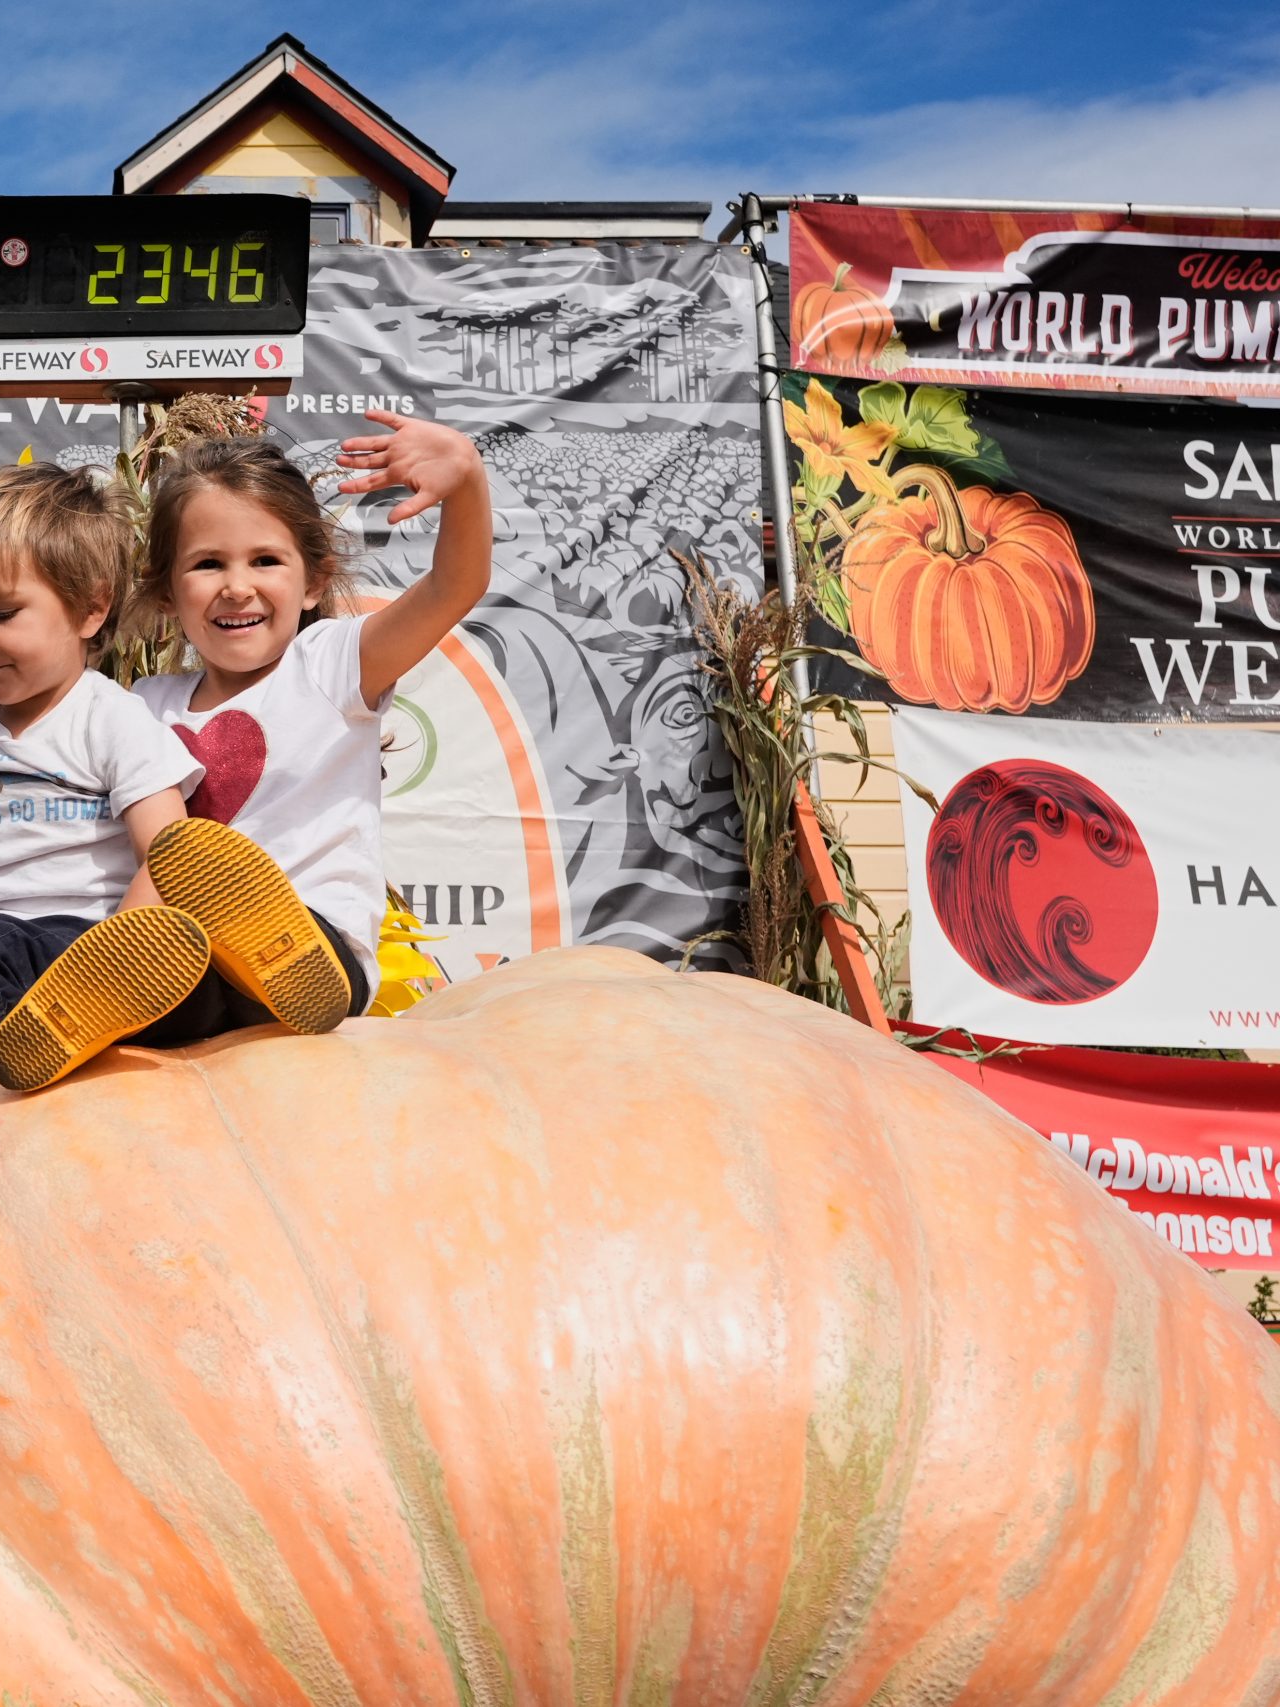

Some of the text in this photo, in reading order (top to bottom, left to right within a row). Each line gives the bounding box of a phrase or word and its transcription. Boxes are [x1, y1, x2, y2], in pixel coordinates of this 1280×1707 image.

[87, 242, 265, 305] 2346
[958, 291, 1280, 362] WORLD PUM
[145, 348, 251, 369] SAFEWAY
[286, 393, 415, 415] PRESENTS
[8, 798, 35, 822] GO
[45, 797, 111, 821] HOME
[1187, 864, 1278, 907] HA
